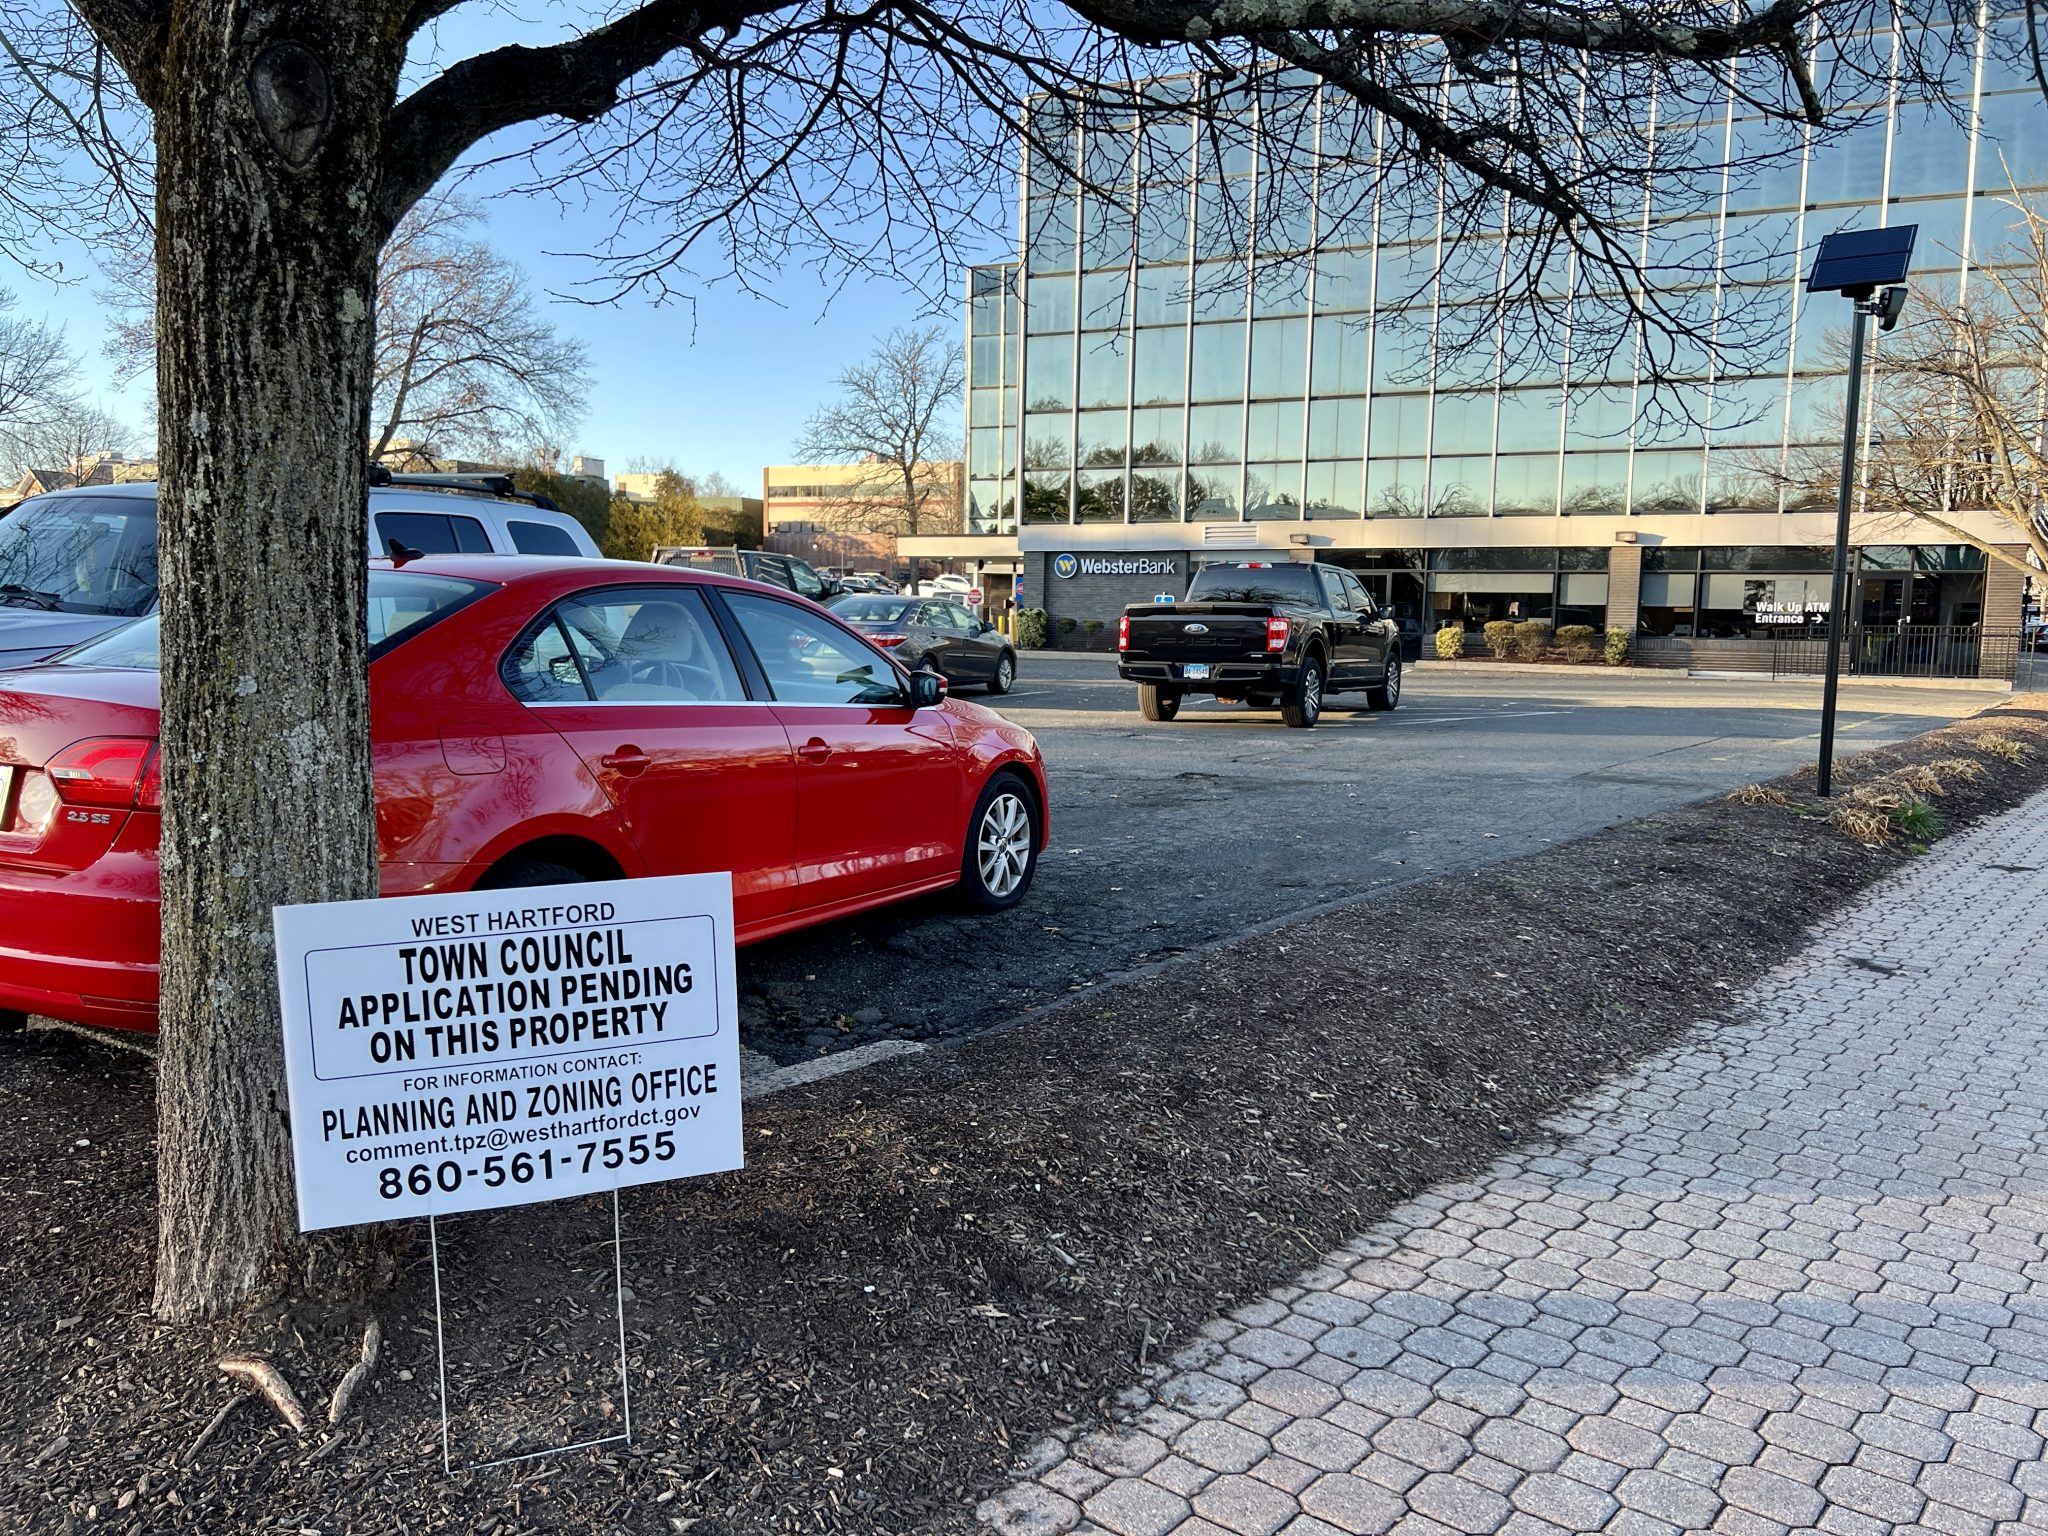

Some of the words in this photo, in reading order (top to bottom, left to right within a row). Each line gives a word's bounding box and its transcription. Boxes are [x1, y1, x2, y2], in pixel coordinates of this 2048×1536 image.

[1080, 558, 1175, 574] WebsterBank
[1755, 613, 1804, 624] Entrance
[1756, 602, 1784, 612] Walk
[1787, 602, 1802, 614] Up
[1804, 602, 1830, 613] ATM
[91, 813, 111, 824] SE
[411, 913, 480, 938] WEST
[487, 902, 616, 931] HARTFORD
[399, 941, 489, 986] TOWN
[500, 928, 633, 976] COUNCIL
[338, 980, 551, 1030] APPLICATION
[560, 962, 694, 1007] PENDING
[370, 1028, 416, 1064] ON
[424, 1020, 500, 1058] THIS
[509, 1000, 669, 1050] PROPERTY
[403, 1076, 440, 1093] FOR
[443, 1063, 558, 1088] INFORMATION
[562, 1051, 642, 1074] CONTACT:
[322, 1091, 456, 1142] PLANNING
[465, 1089, 518, 1126] AND
[526, 1075, 622, 1119] ZONING
[631, 1063, 718, 1104] OFFICE
[345, 1104, 701, 1164] comment.tpz@westhartfordct.gov
[379, 1129, 676, 1200] 860-561-7555
